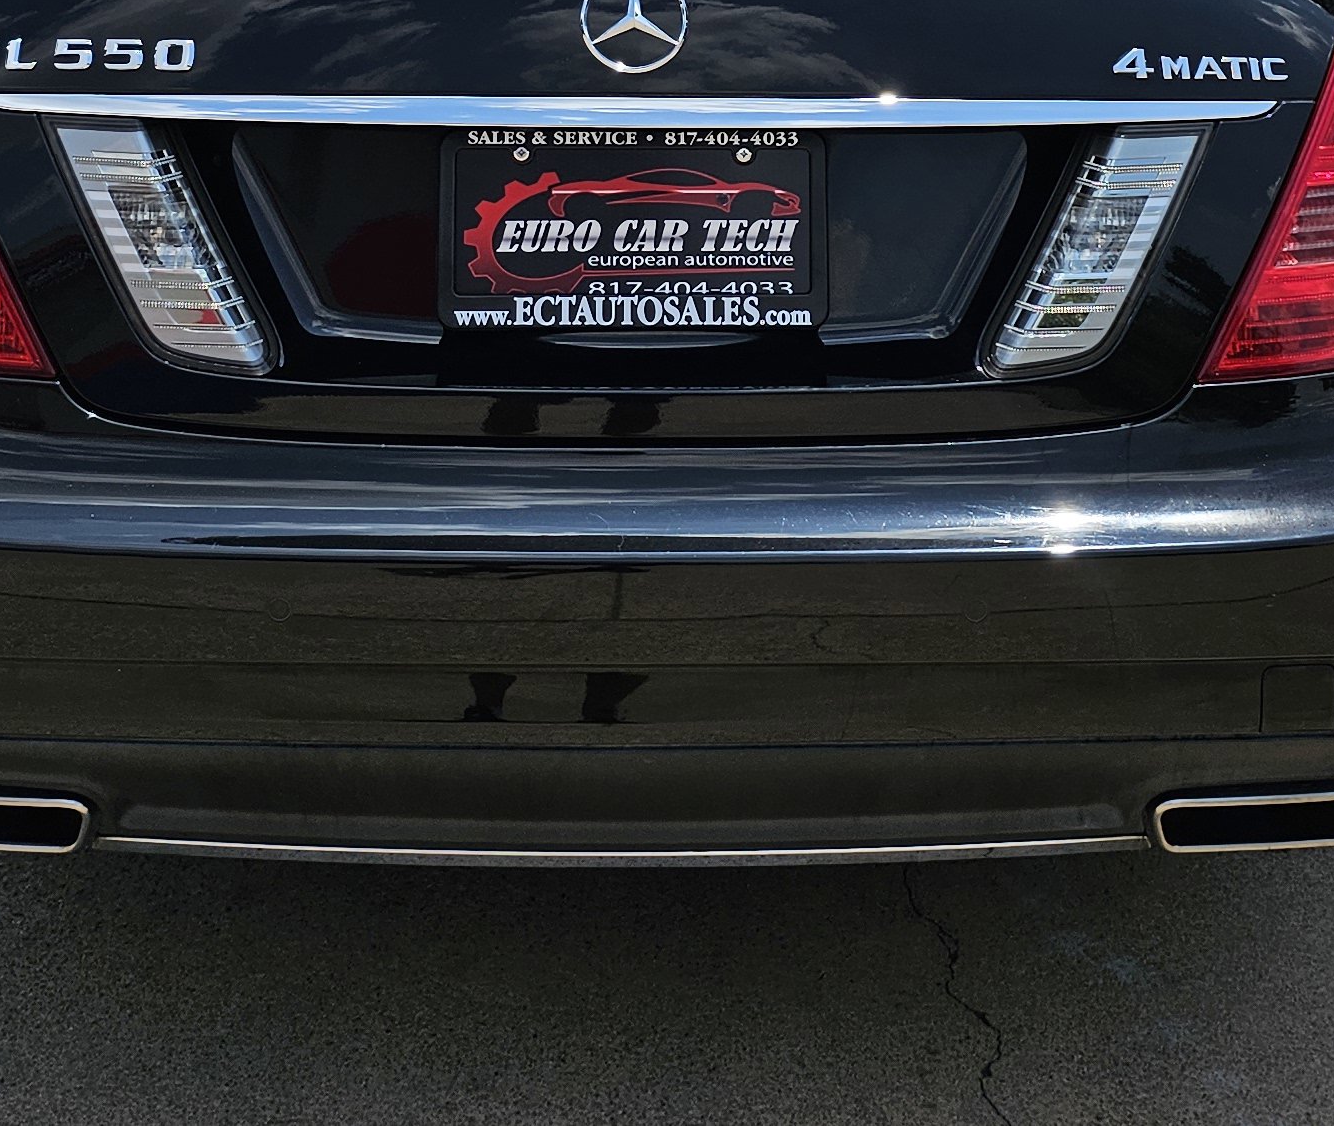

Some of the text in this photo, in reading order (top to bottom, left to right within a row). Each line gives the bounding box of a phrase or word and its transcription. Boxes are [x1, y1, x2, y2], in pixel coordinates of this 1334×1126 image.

[53, 38, 196, 71] 550
[467, 130, 799, 147] SALES & SERVICE 817-404-4033
[495, 219, 800, 253] EURO CAR TECH
[587, 252, 794, 270] european automotive
[588, 281, 794, 295] 817-404-4033
[453, 294, 813, 327] www.ECTAUTOSALES.com
